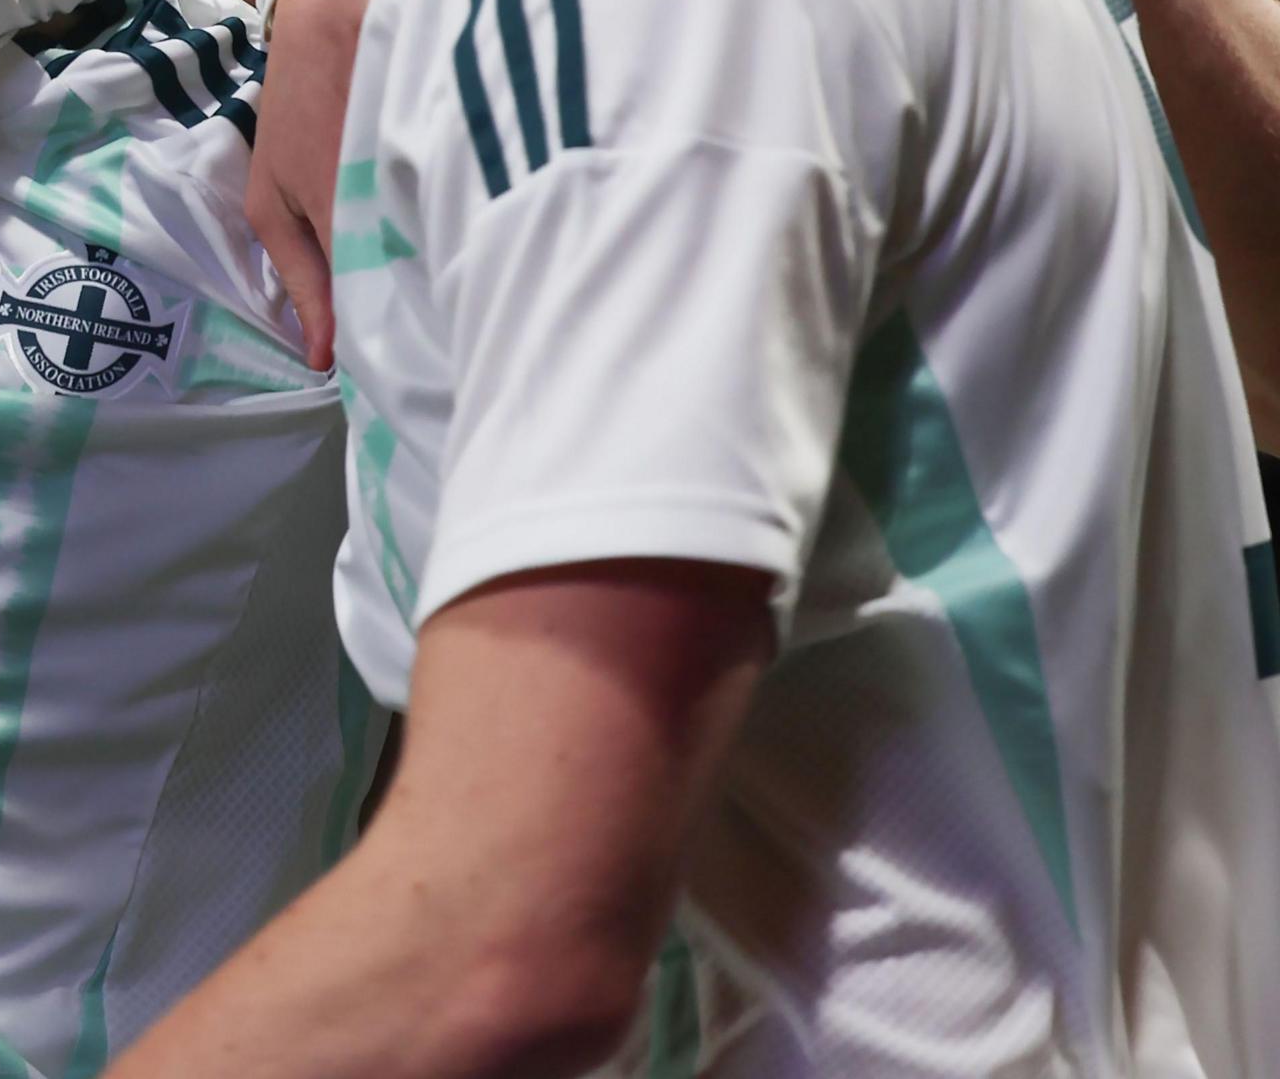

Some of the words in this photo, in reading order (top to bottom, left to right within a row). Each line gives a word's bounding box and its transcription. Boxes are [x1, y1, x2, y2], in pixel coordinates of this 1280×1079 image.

[33, 268, 77, 298] IRISH
[80, 266, 146, 318] FOOTBALL
[14, 305, 95, 334] NORTHERN
[92, 321, 152, 346] IRELAND
[23, 344, 127, 391] ASSOCIATION
